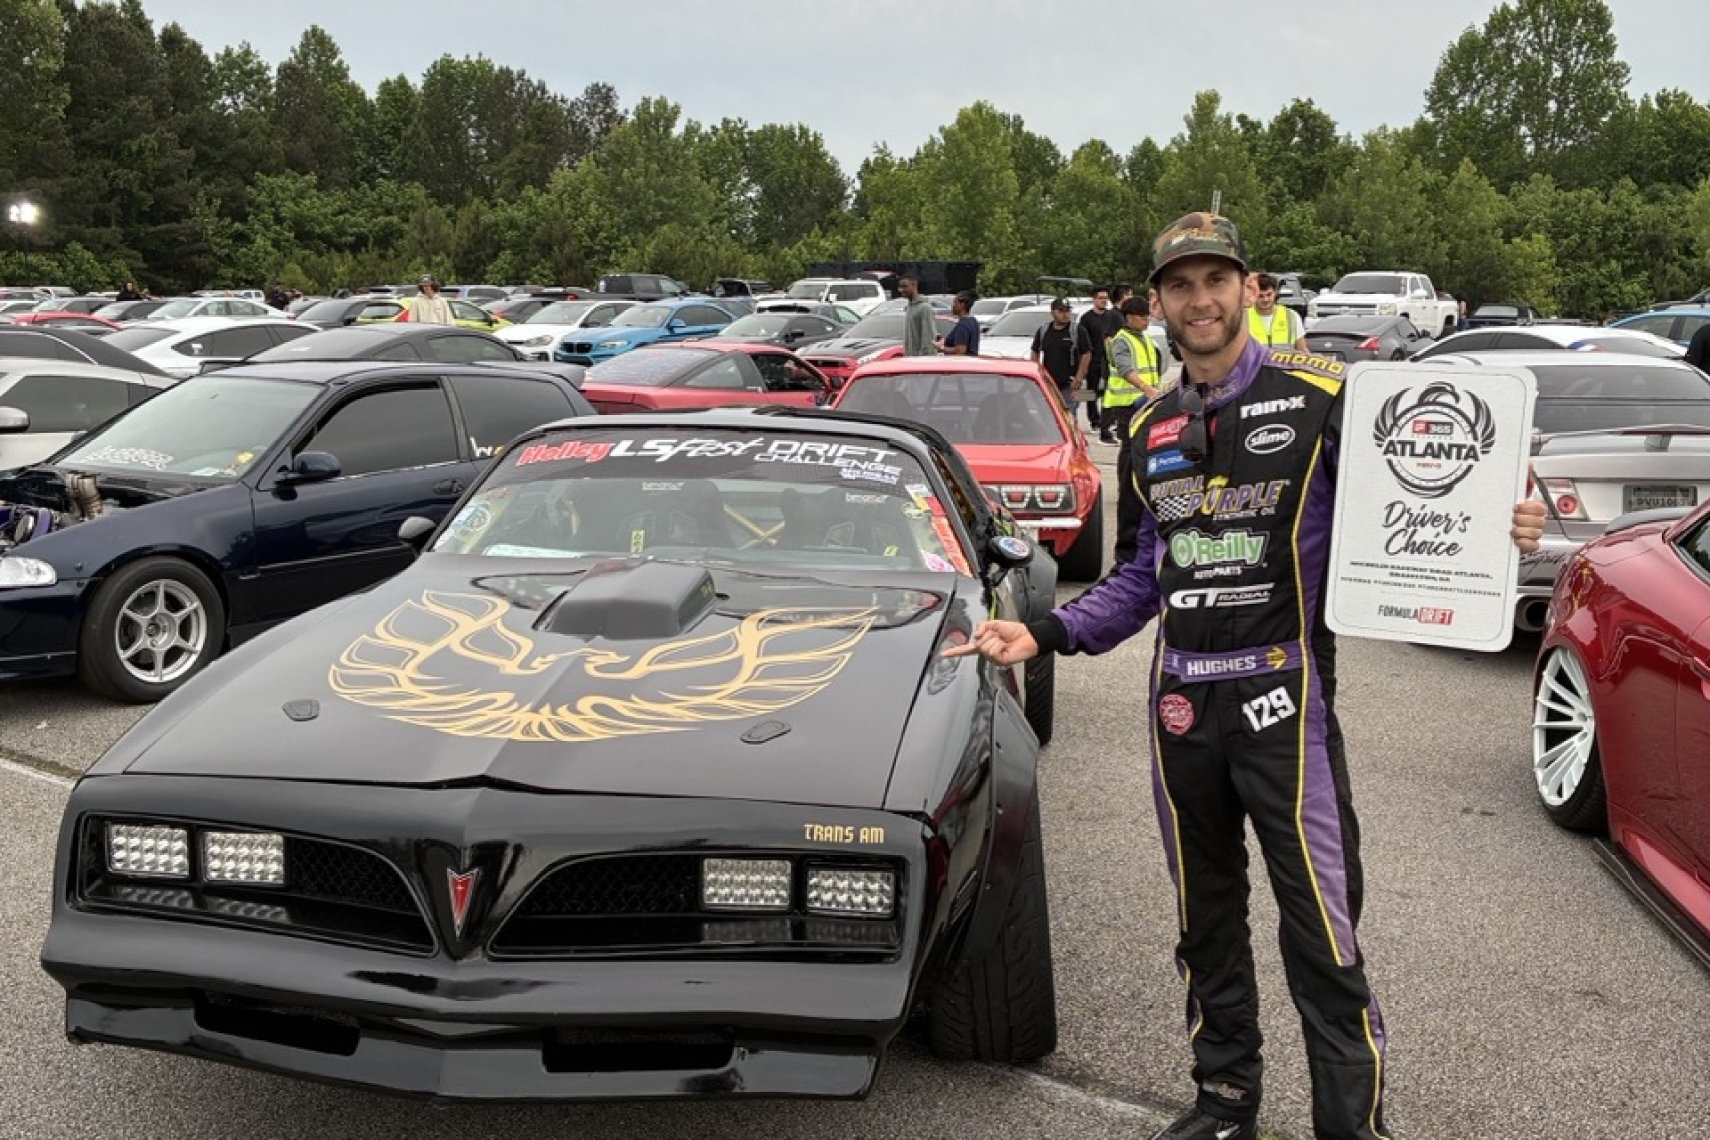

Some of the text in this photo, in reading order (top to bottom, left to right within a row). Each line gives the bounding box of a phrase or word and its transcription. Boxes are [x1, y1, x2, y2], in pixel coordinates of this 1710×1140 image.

[516, 441, 614, 466] Holley
[768, 440, 898, 463] DRIFT
[753, 452, 902, 475] CHALLENGE
[1383, 440, 1480, 462] ATLANTA
[1182, 479, 1282, 518] PURPLE
[1382, 500, 1472, 534] Driver's
[1171, 530, 1265, 568] O'Reilly
[1384, 528, 1463, 556] Choice
[1378, 604, 1452, 624] FORMULA DRIFT
[1187, 655, 1257, 676] HUGHES
[1242, 685, 1297, 732] 129
[803, 824, 884, 843] TRANS AM
